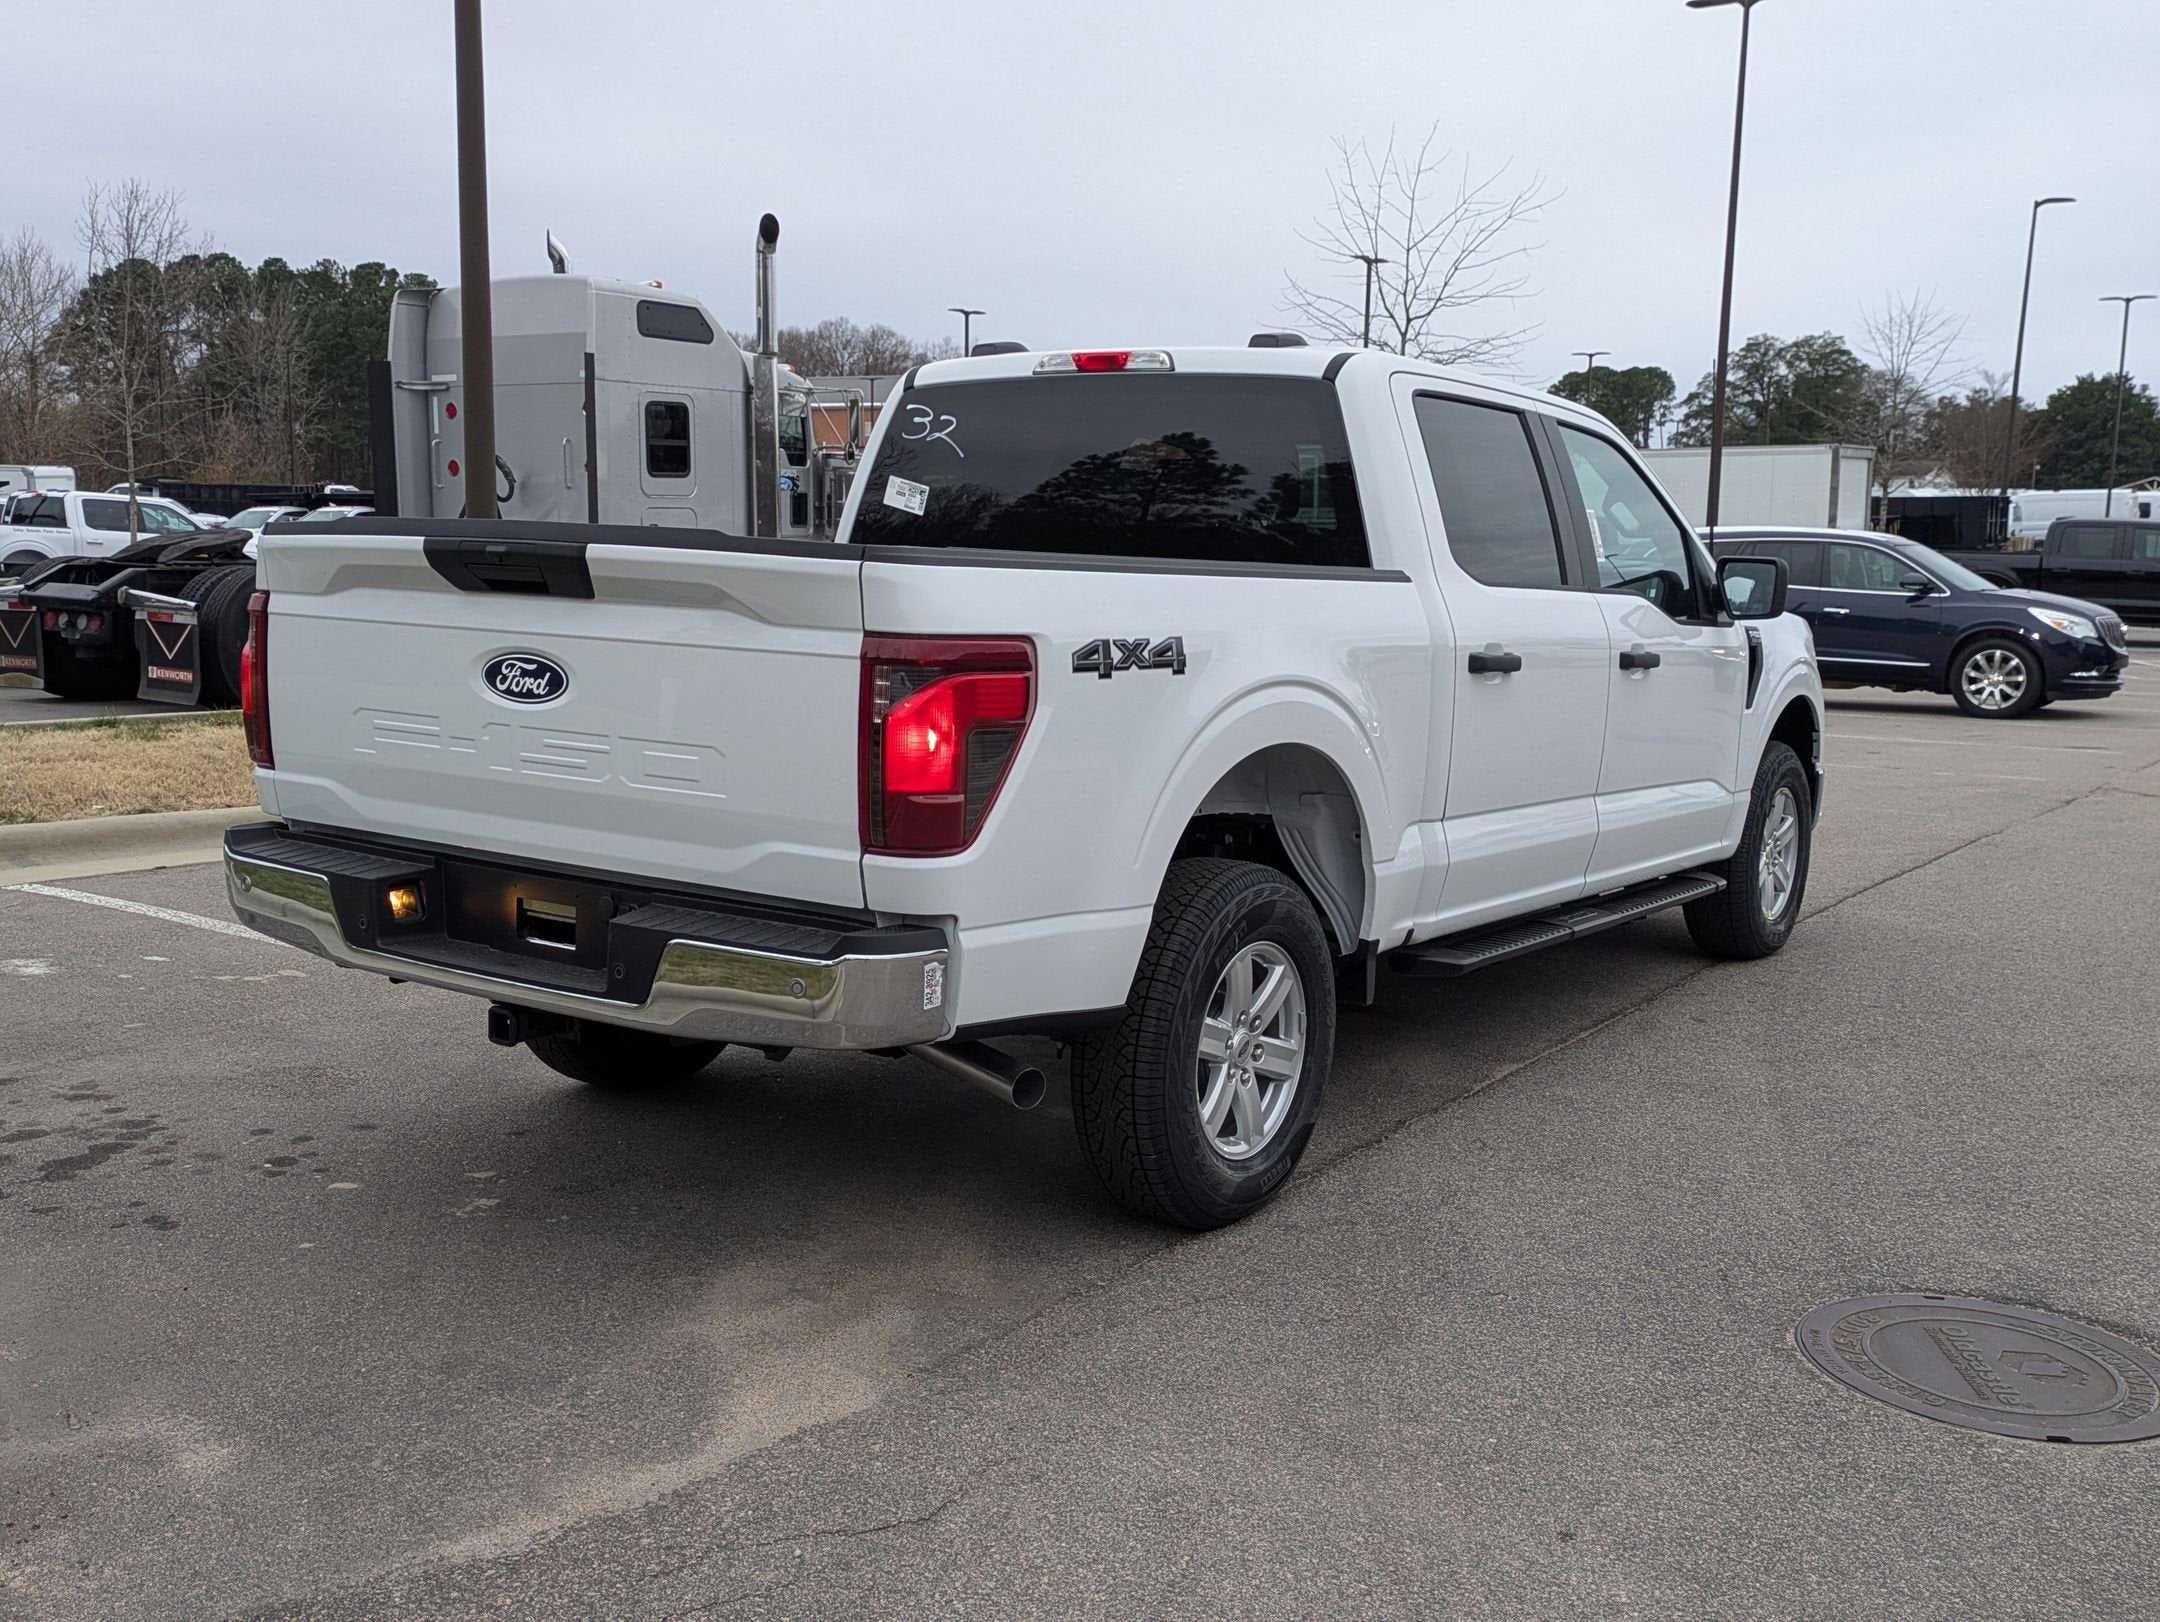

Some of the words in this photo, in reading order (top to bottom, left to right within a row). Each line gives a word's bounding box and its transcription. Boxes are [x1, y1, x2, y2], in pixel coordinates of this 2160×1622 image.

[902, 404, 964, 458] 32
[157, 668, 193, 682] KENWORTH
[496, 660, 551, 695] Ford
[1937, 1325, 2024, 1406] Oldcastle
